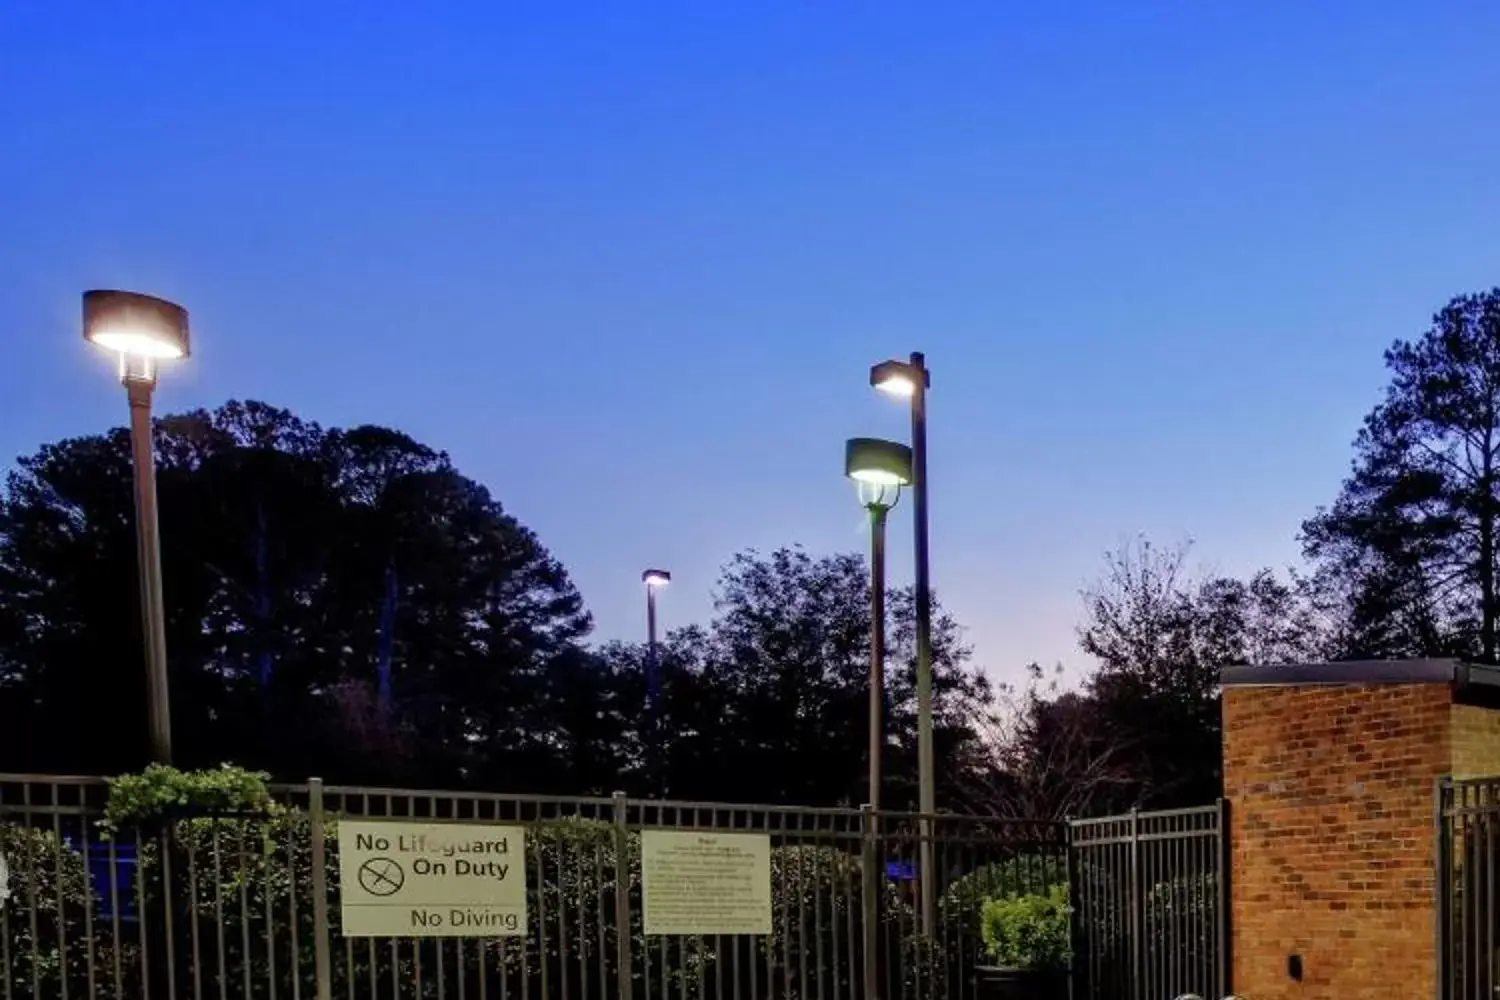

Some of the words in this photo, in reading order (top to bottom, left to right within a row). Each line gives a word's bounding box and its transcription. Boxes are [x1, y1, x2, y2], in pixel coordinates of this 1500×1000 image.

[356, 833, 389, 851] No
[413, 858, 446, 875] On
[455, 859, 508, 881] Duty
[411, 909, 443, 927] No
[450, 908, 518, 930] Diving
